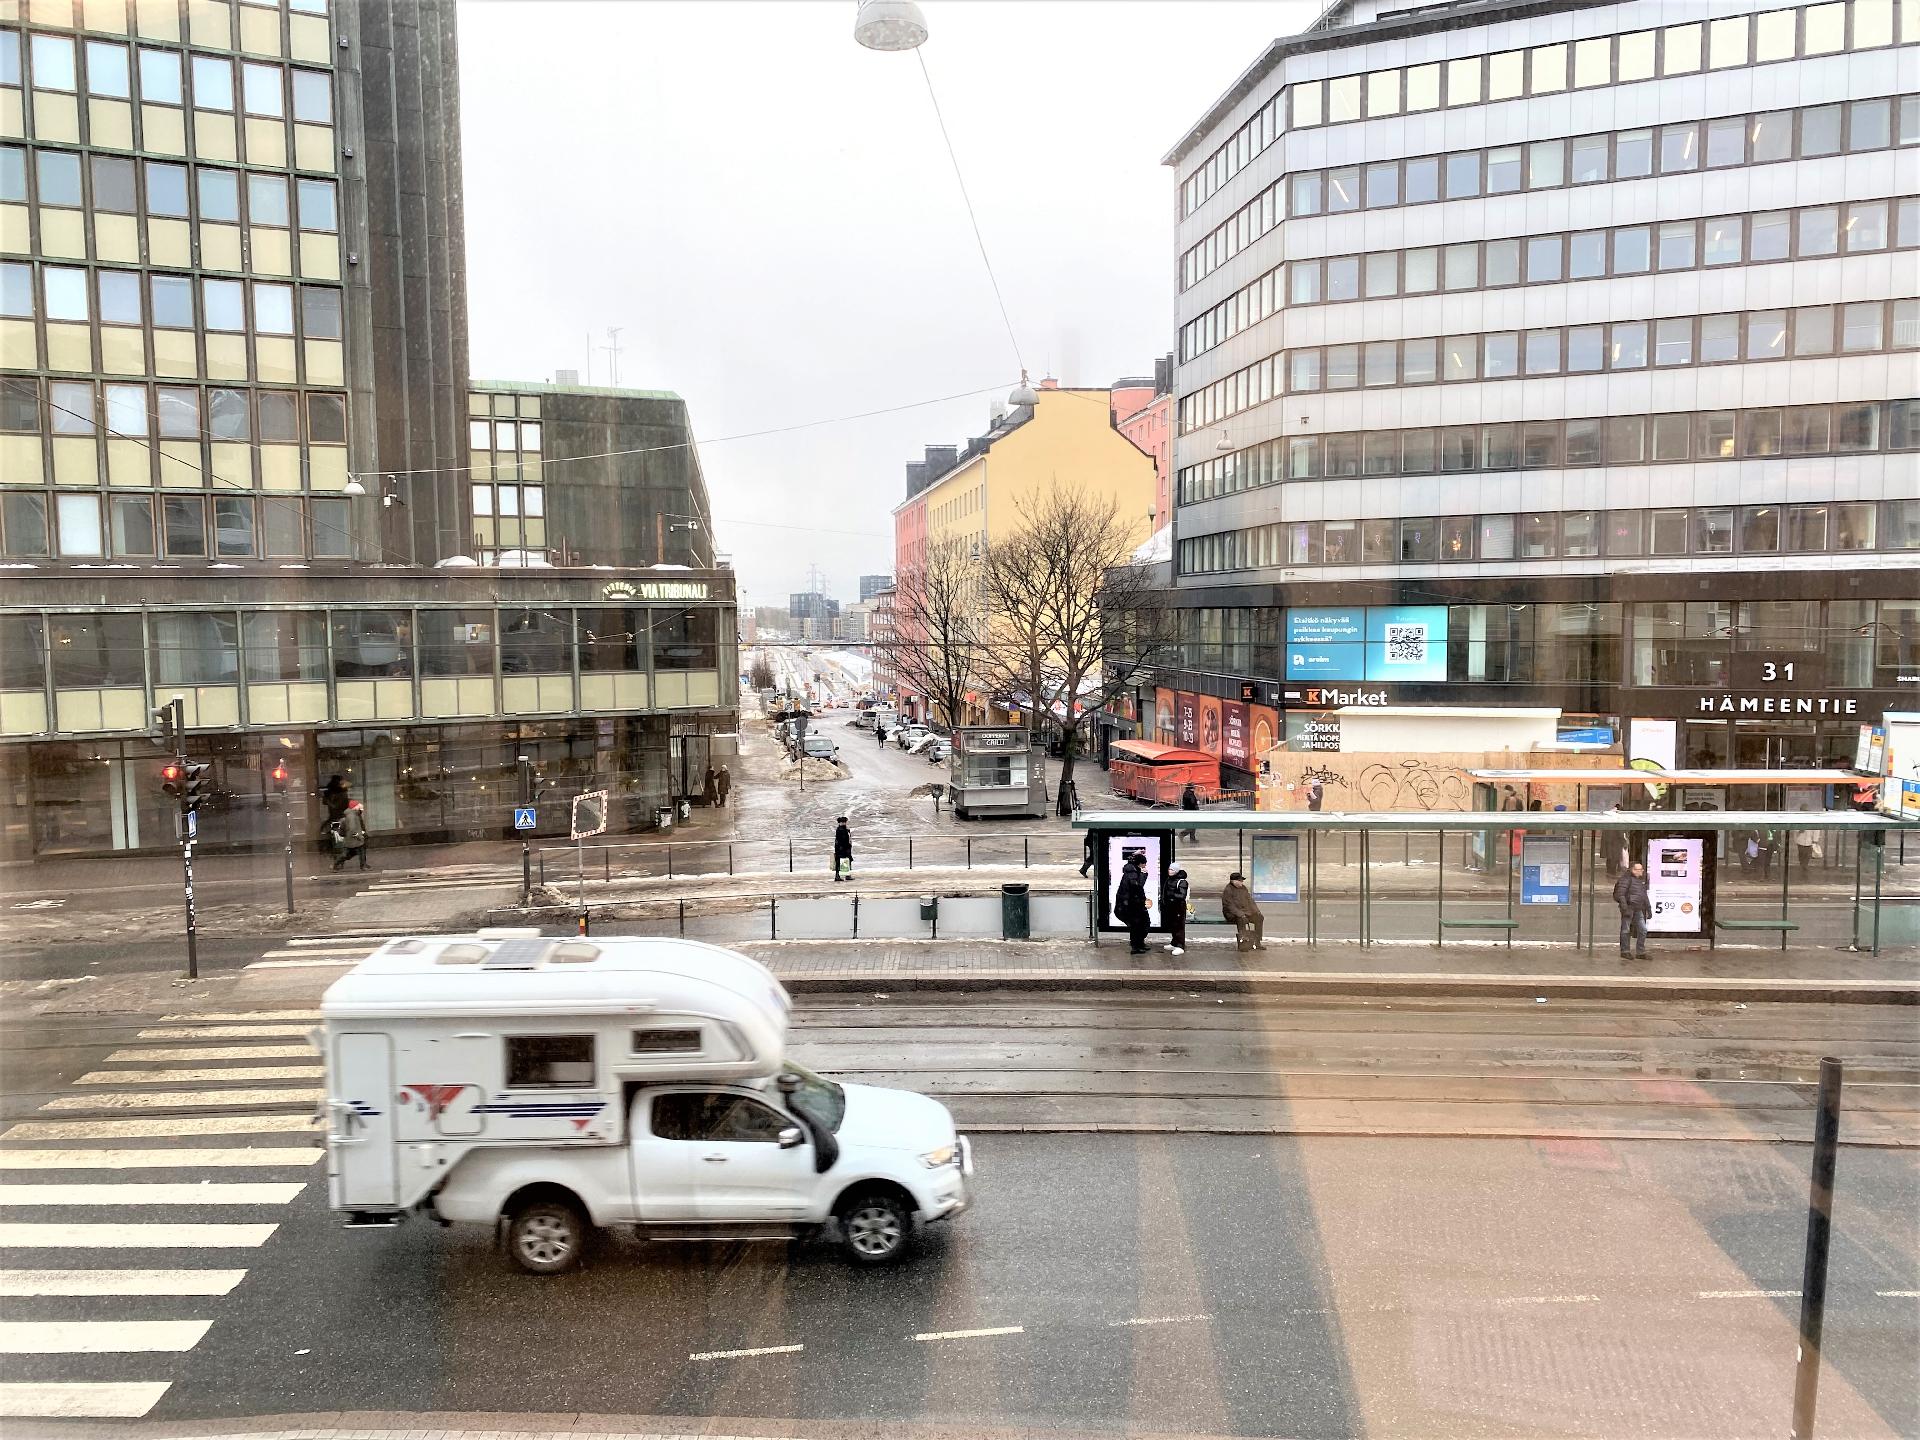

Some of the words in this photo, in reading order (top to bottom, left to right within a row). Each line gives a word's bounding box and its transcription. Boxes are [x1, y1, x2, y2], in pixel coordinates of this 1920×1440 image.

[640, 583, 659, 598] VIA
[659, 583, 707, 598] TRIBUNALI
[1321, 626, 1358, 634] kaupungin
[1762, 662, 1794, 681] 31
[1321, 688, 1388, 706] Market
[1700, 695, 1857, 714] HÄMEENTIE
[1655, 902, 1663, 914] 5
